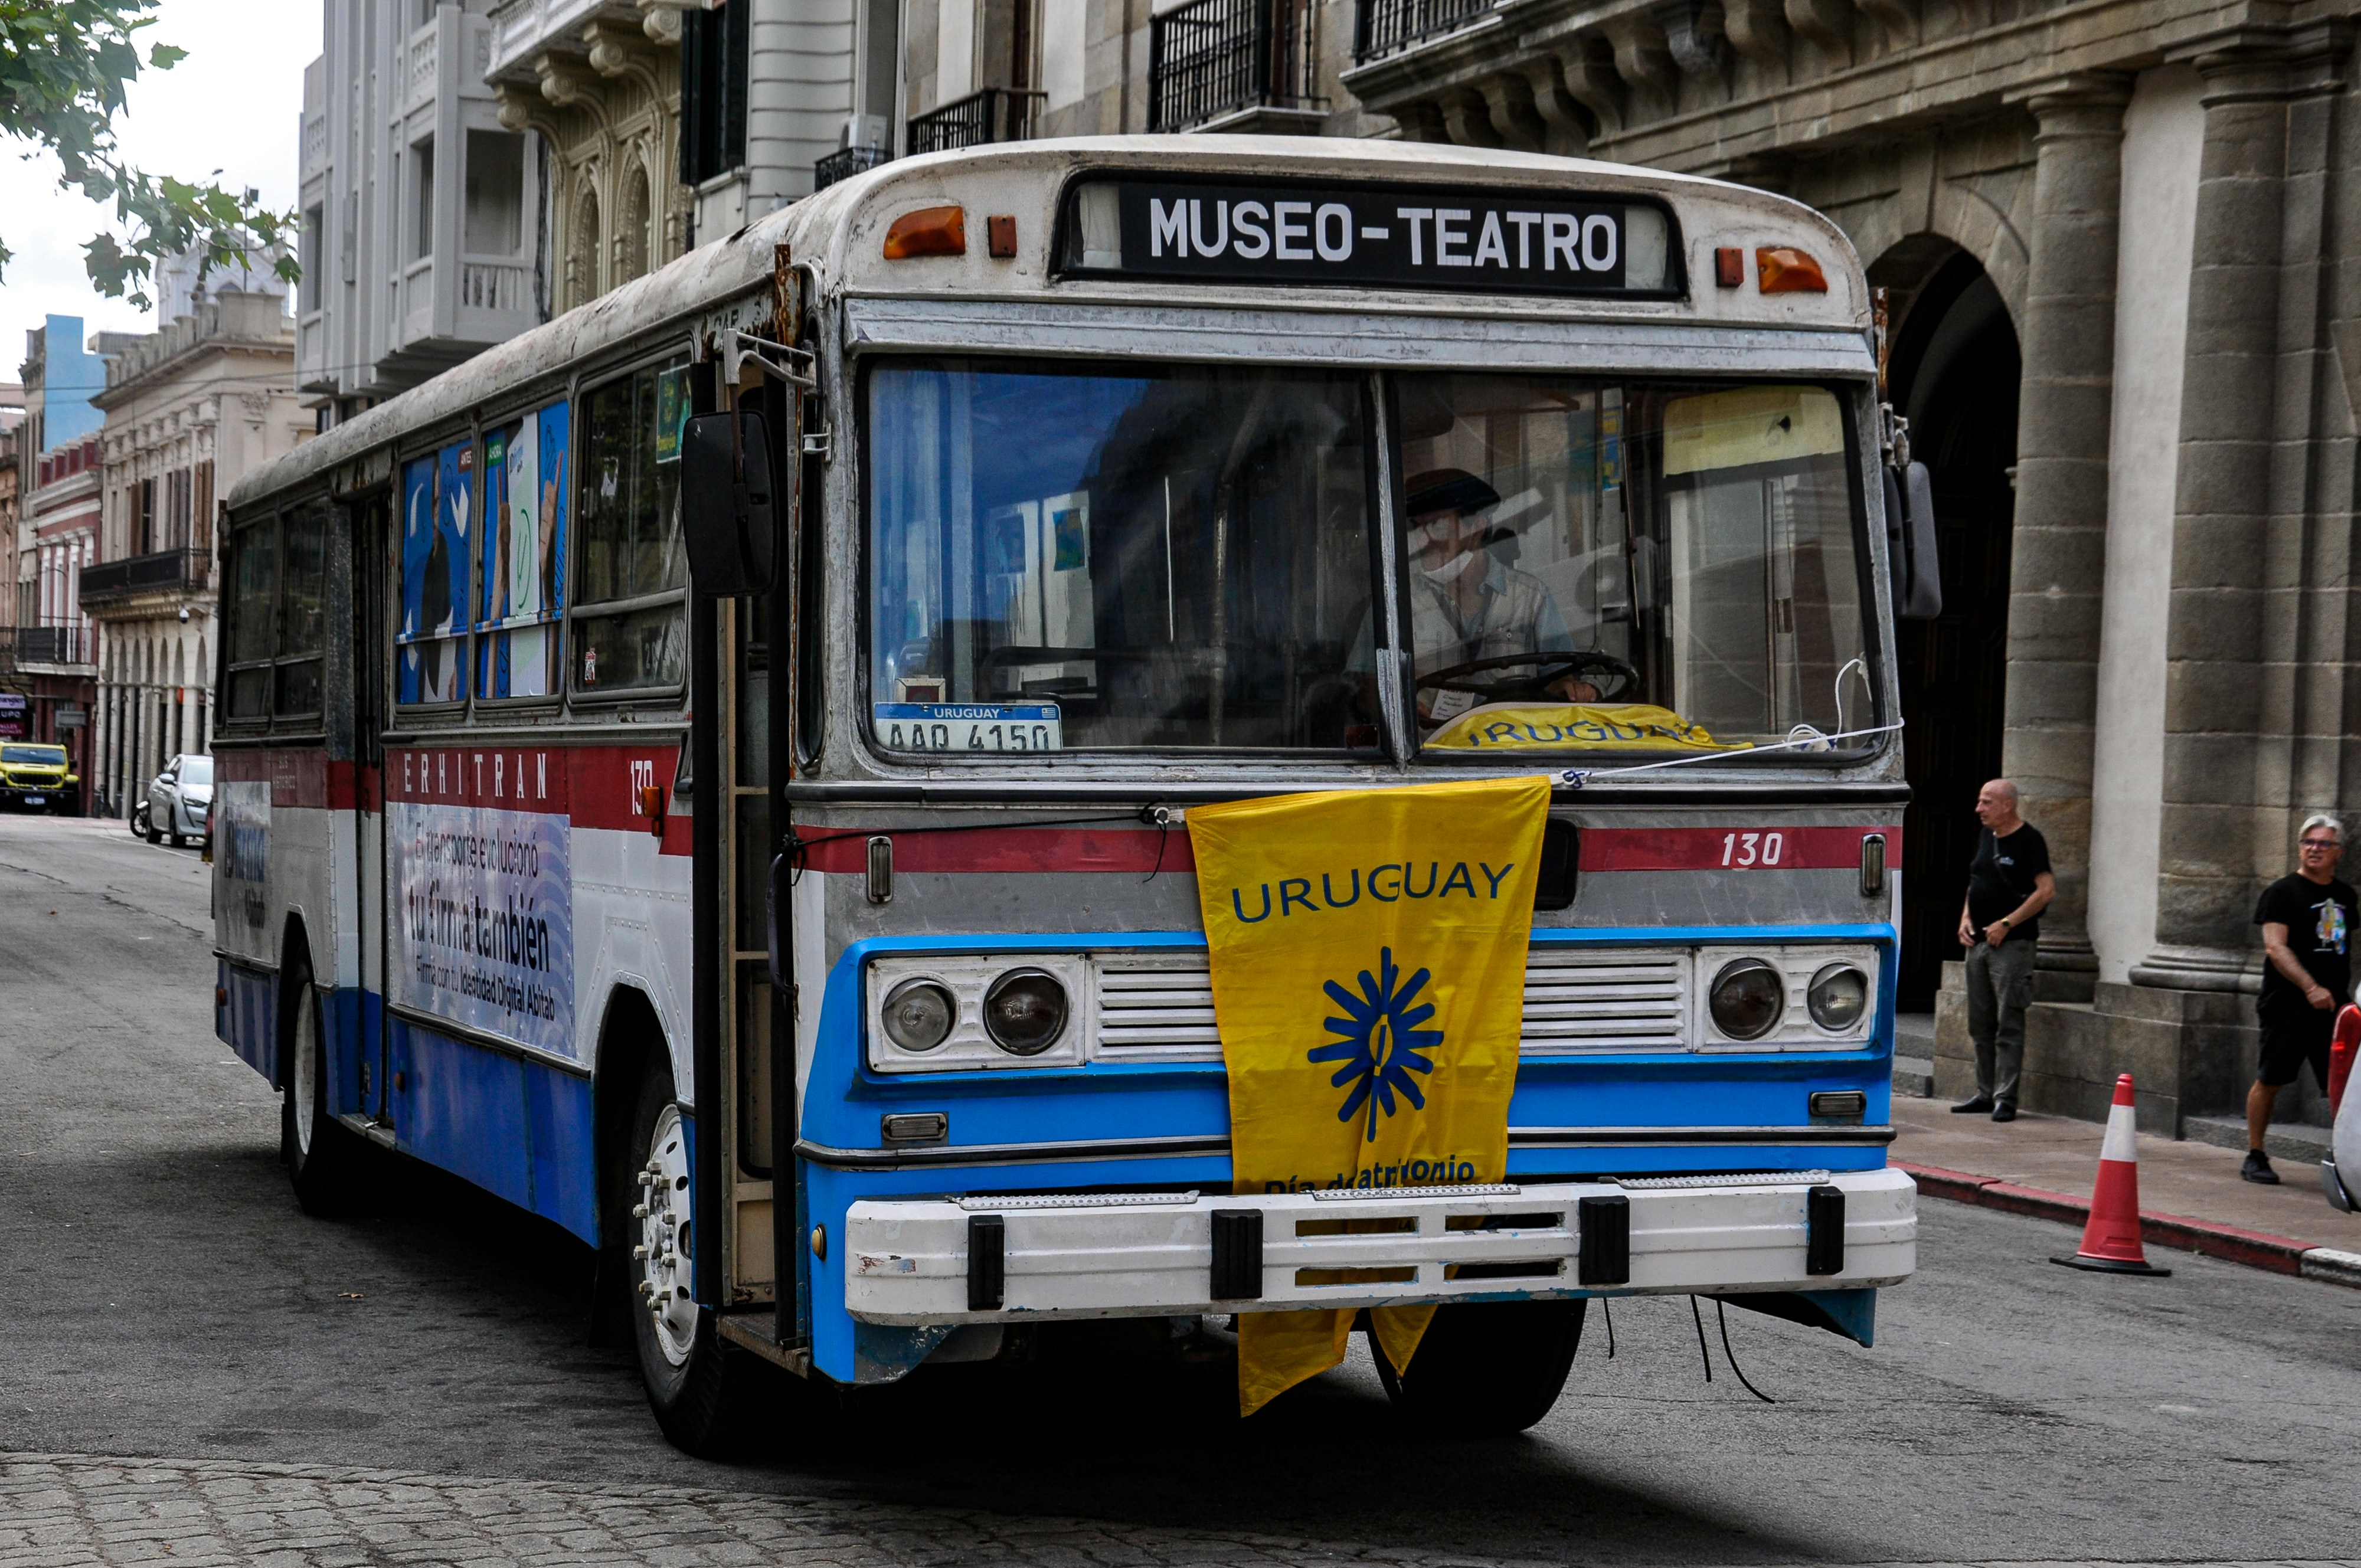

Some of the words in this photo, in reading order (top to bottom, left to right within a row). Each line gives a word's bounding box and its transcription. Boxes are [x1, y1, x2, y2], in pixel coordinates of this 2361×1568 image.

[934, 708, 1000, 719] URUGUAY
[967, 724, 1049, 751] 4150
[404, 753, 547, 799] ERHITRAN
[426, 827, 477, 873] transporte
[479, 827, 538, 878] evolucionó
[1722, 833, 1782, 866] 130
[1231, 862, 1515, 924] URUGUAY
[409, 885, 425, 942] tu
[429, 879, 471, 952] firma
[475, 892, 550, 973] también
[416, 954, 436, 986] Firma
[437, 966, 449, 990] con
[460, 965, 496, 1004] Identidad
[498, 976, 525, 1017] Digital
[527, 983, 555, 1022] Abitab
